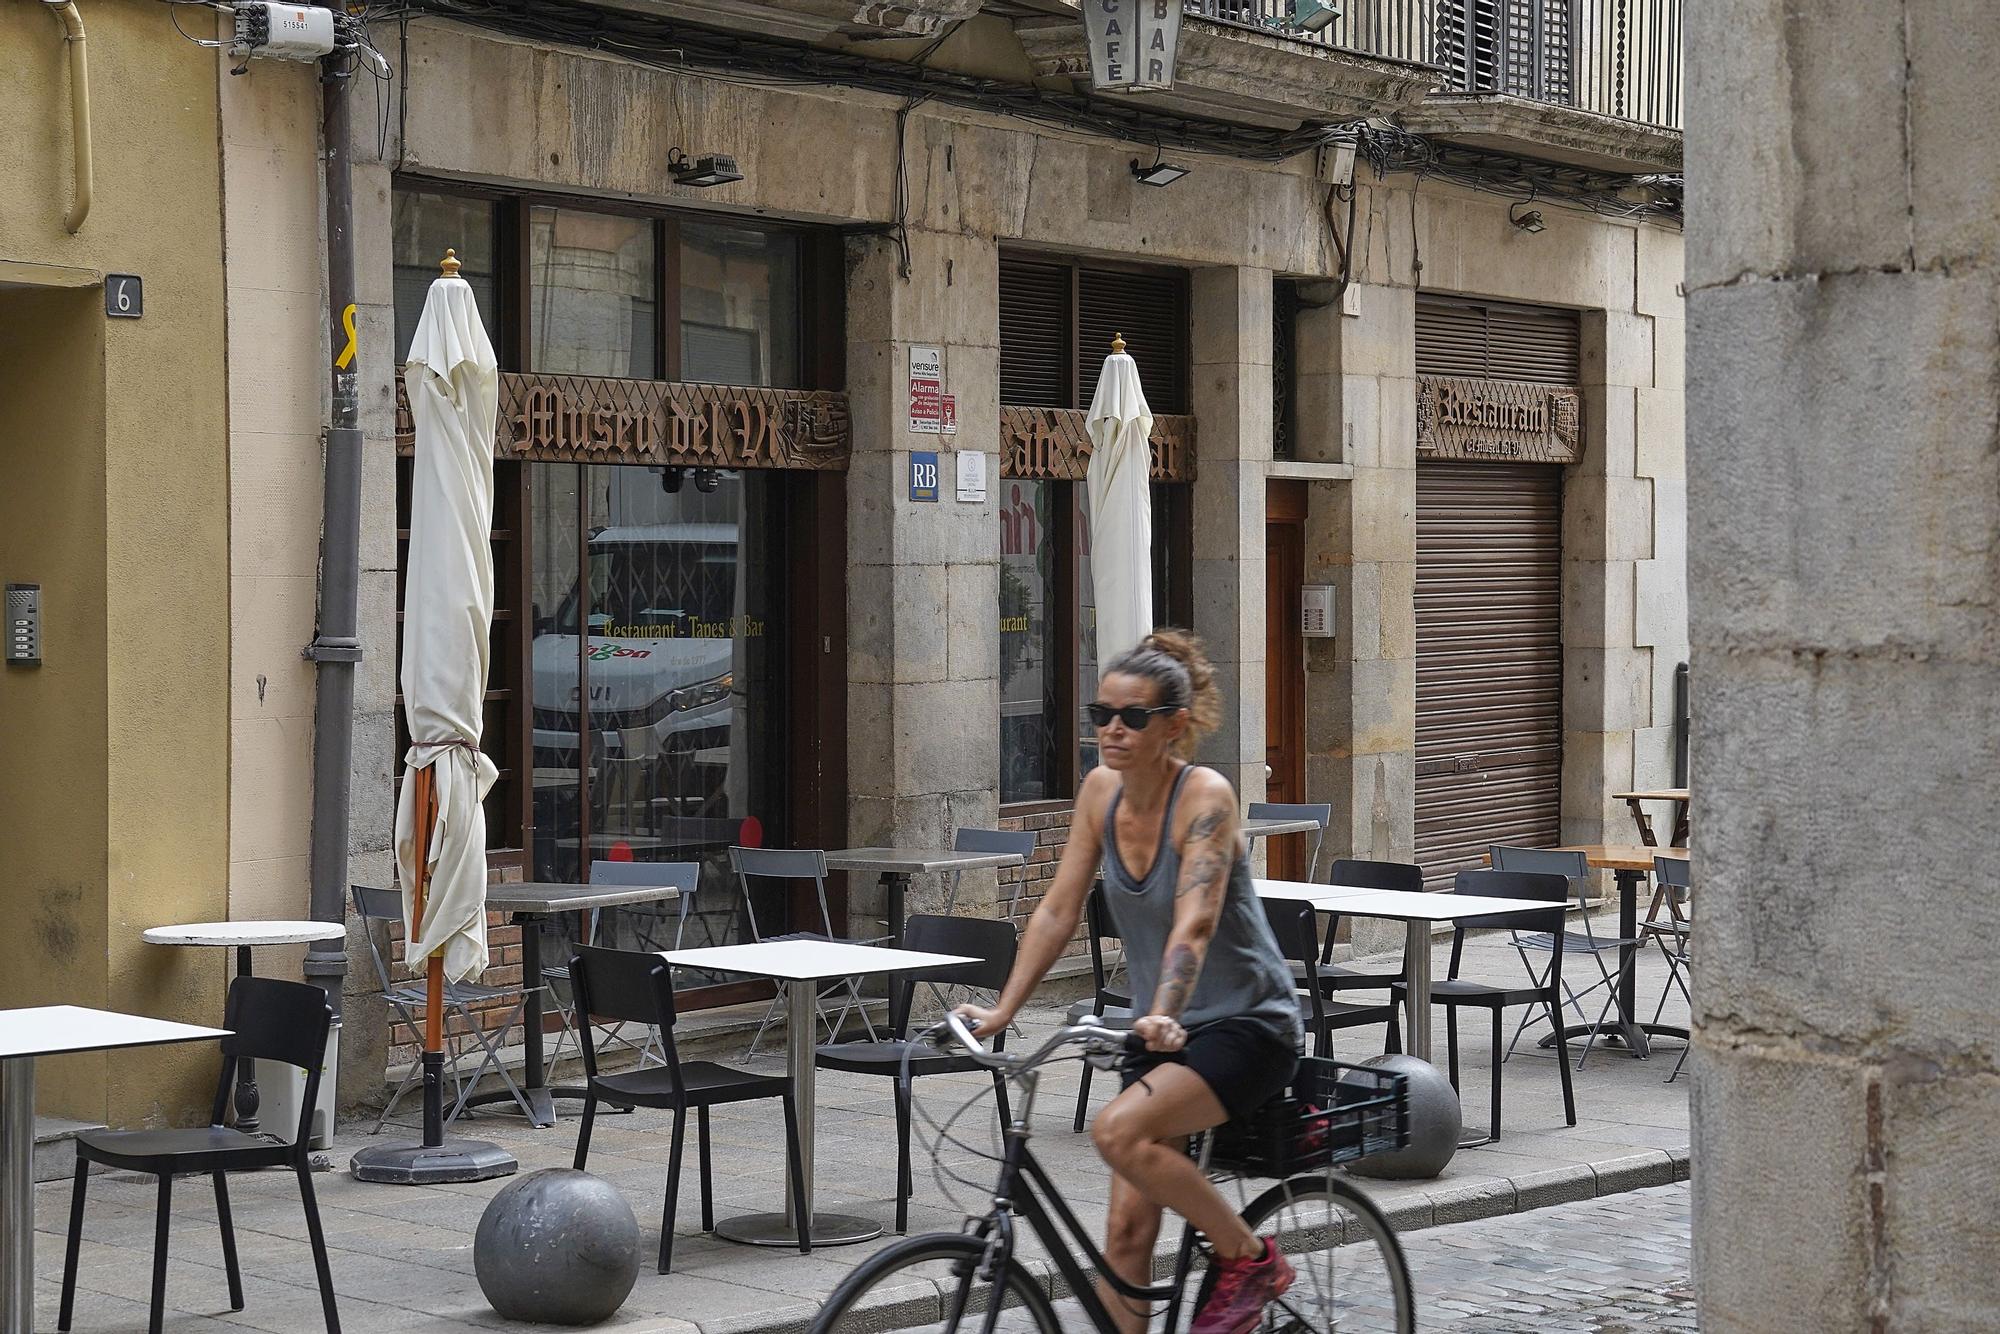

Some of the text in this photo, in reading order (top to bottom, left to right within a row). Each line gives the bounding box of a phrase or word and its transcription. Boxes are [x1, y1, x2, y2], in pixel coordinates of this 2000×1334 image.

[1149, 0, 1168, 82] BAR
[117, 280, 130, 312] 6
[911, 382, 939, 394] Alarma
[514, 386, 655, 453] Museu
[667, 399, 723, 456] del
[1150, 436, 1178, 478] ar
[912, 463, 937, 488] RB
[603, 618, 676, 638] Restaurant
[743, 615, 765, 637] Bar
[1000, 613, 1028, 632] urant
